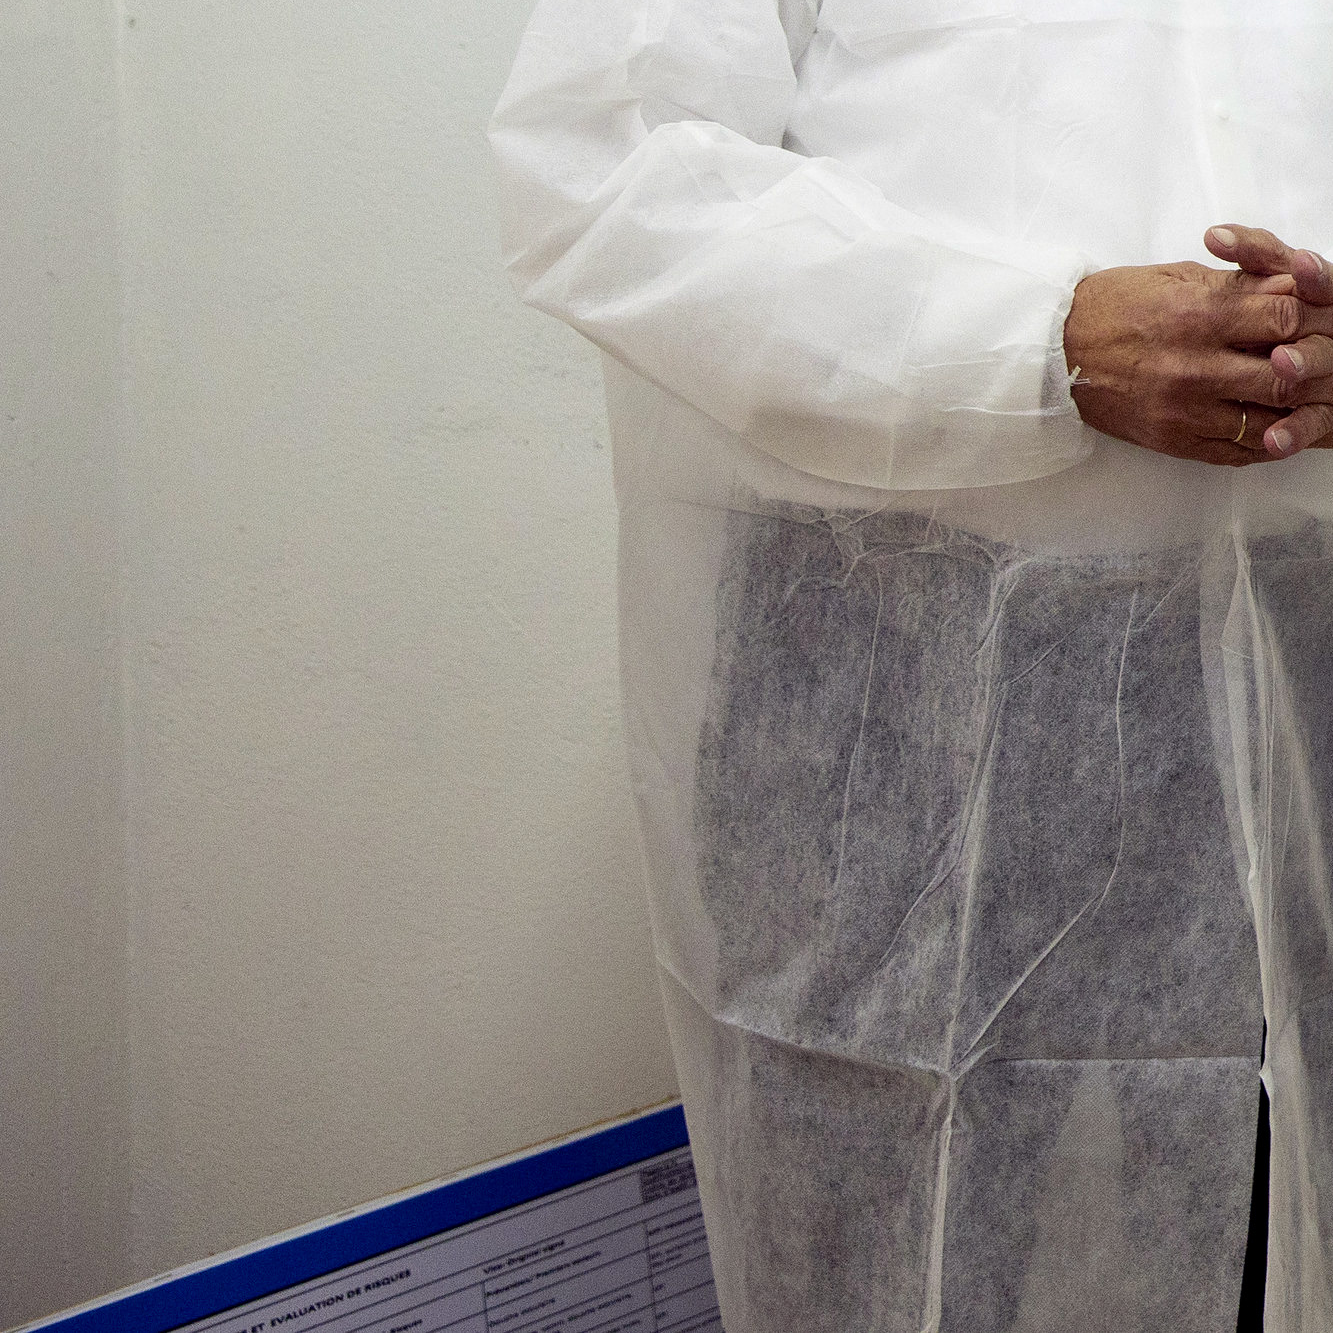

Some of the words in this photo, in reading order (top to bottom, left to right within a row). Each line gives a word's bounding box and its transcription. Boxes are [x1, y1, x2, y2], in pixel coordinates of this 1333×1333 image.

[270, 1293, 345, 1328] EVALUATION
[346, 1287, 362, 1299] DE
[363, 1269, 411, 1294] RISQUES
